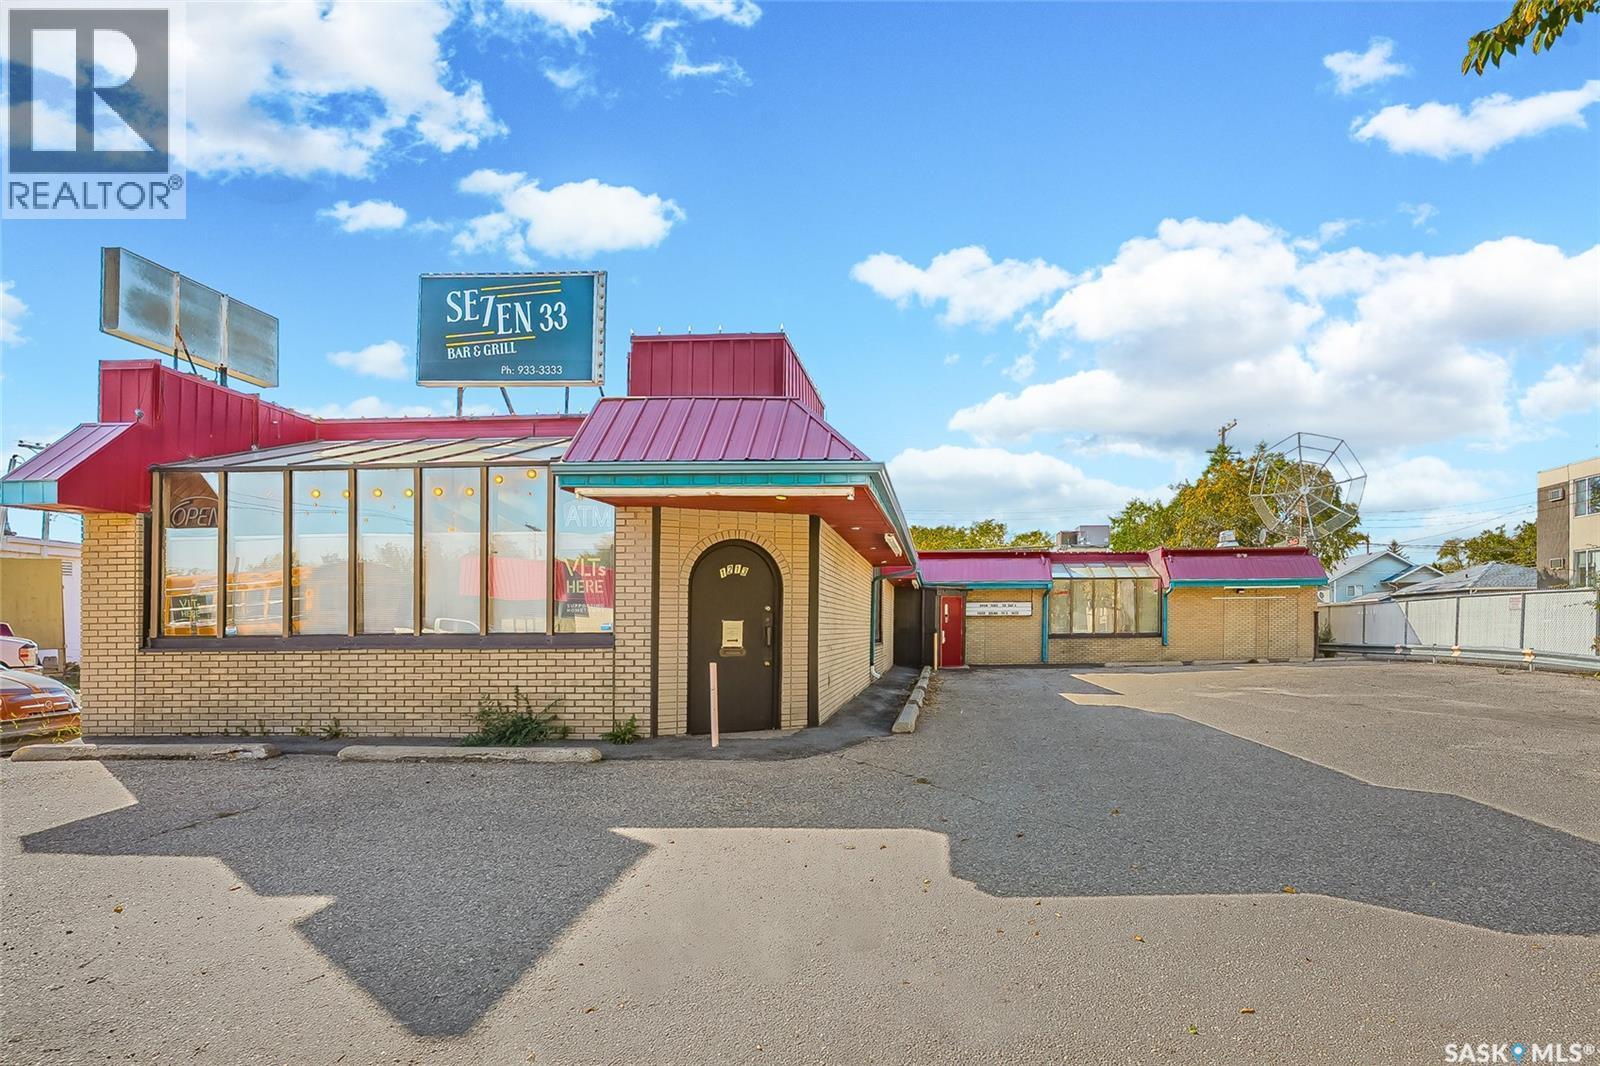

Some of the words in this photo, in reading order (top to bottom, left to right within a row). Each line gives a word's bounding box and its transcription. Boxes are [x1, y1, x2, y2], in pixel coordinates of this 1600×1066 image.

[446, 288, 533, 335] SE7EN
[539, 301, 568, 332] 33
[447, 345, 471, 360] BAR
[473, 345, 481, 358] &
[483, 341, 517, 356] GRILL
[501, 365, 515, 375] Ph:
[517, 365, 563, 375] 933-3333
[172, 506, 218, 527] OPEN
[564, 504, 611, 528] ATM
[564, 557, 606, 577] VLTs
[566, 579, 604, 594] HERE
